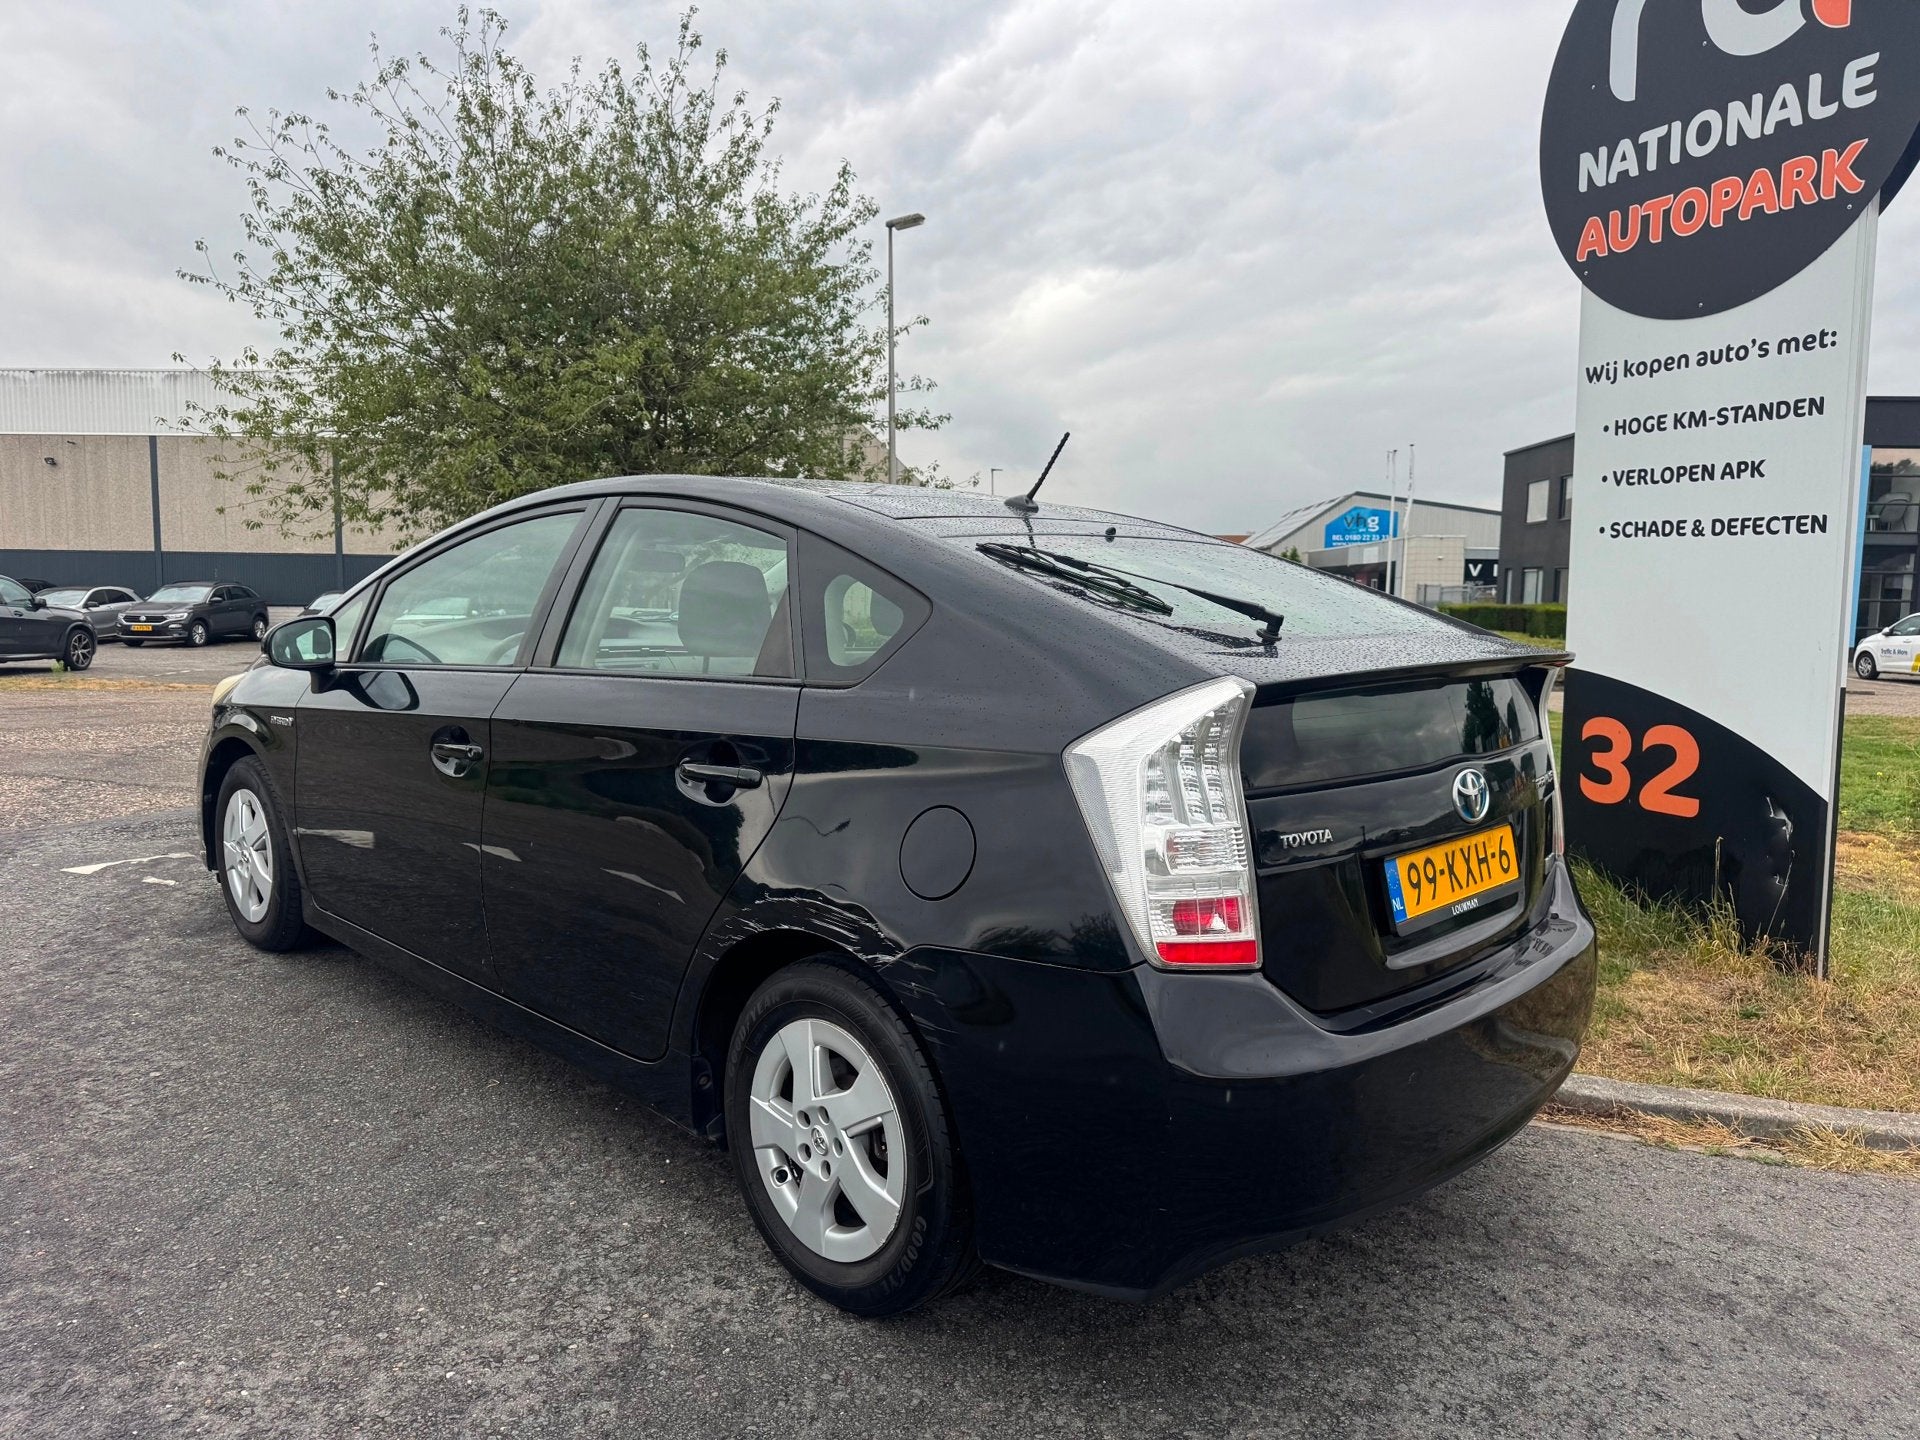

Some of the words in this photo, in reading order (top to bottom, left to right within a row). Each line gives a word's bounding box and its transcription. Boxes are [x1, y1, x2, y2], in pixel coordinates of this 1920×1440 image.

[1578, 51, 1880, 192] NATIONALE
[1576, 138, 1869, 262] AUTOPARK
[1585, 360, 1618, 385] Wij
[1623, 353, 1690, 378] kopen
[1696, 338, 1770, 367] auto's
[1777, 328, 1838, 355] met:
[1614, 414, 1668, 436] HOGE
[1673, 396, 1825, 430] KM-STANDEN
[1612, 463, 1716, 487] VERLOPEN
[1720, 459, 1767, 480] APK
[1344, 513, 1380, 532] vhg
[1610, 519, 1688, 539] SCHADE
[1691, 518, 1706, 538] &
[1710, 514, 1828, 537] DEFECTEN
[1579, 716, 1700, 818] 32
[1280, 829, 1334, 849] TOYOTA
[1407, 835, 1511, 906] 99-KXH-6
[1392, 897, 1404, 911] NL
